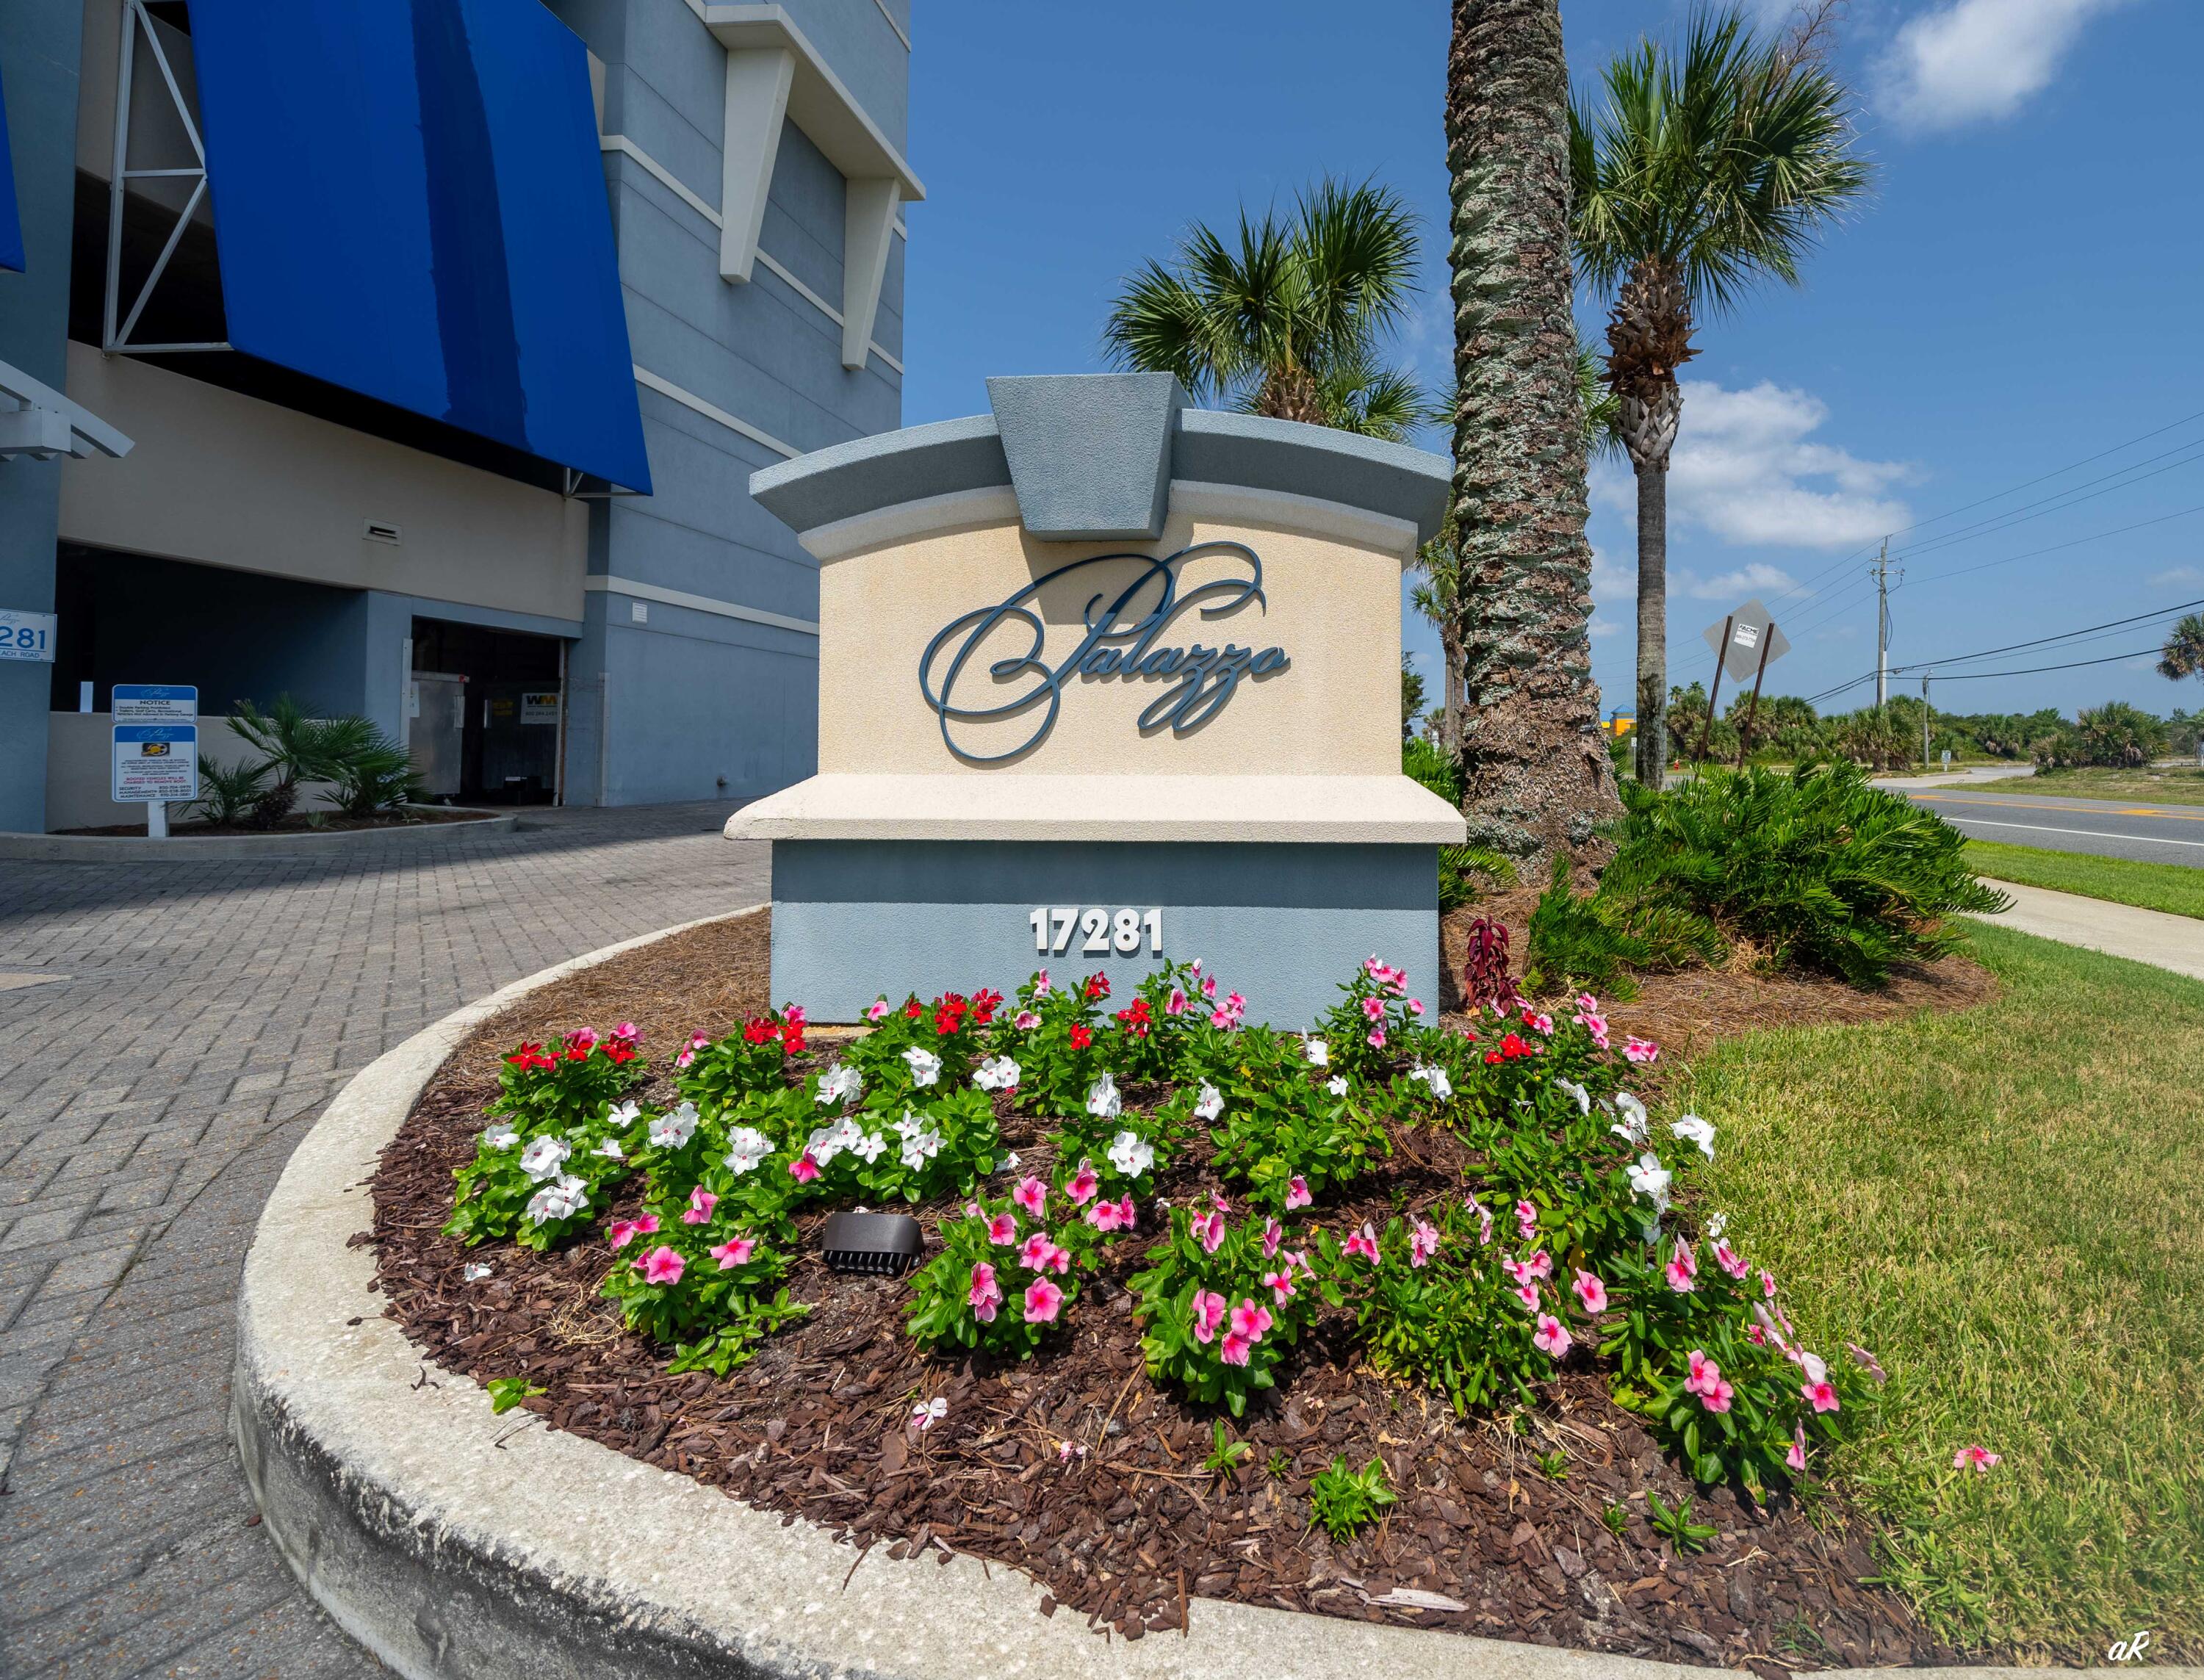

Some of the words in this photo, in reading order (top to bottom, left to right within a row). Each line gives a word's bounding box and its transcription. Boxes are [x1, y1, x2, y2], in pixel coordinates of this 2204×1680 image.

[0, 626, 46, 649] 281
[919, 541, 1291, 761] Palazzo
[1029, 908, 1163, 952] 17281
